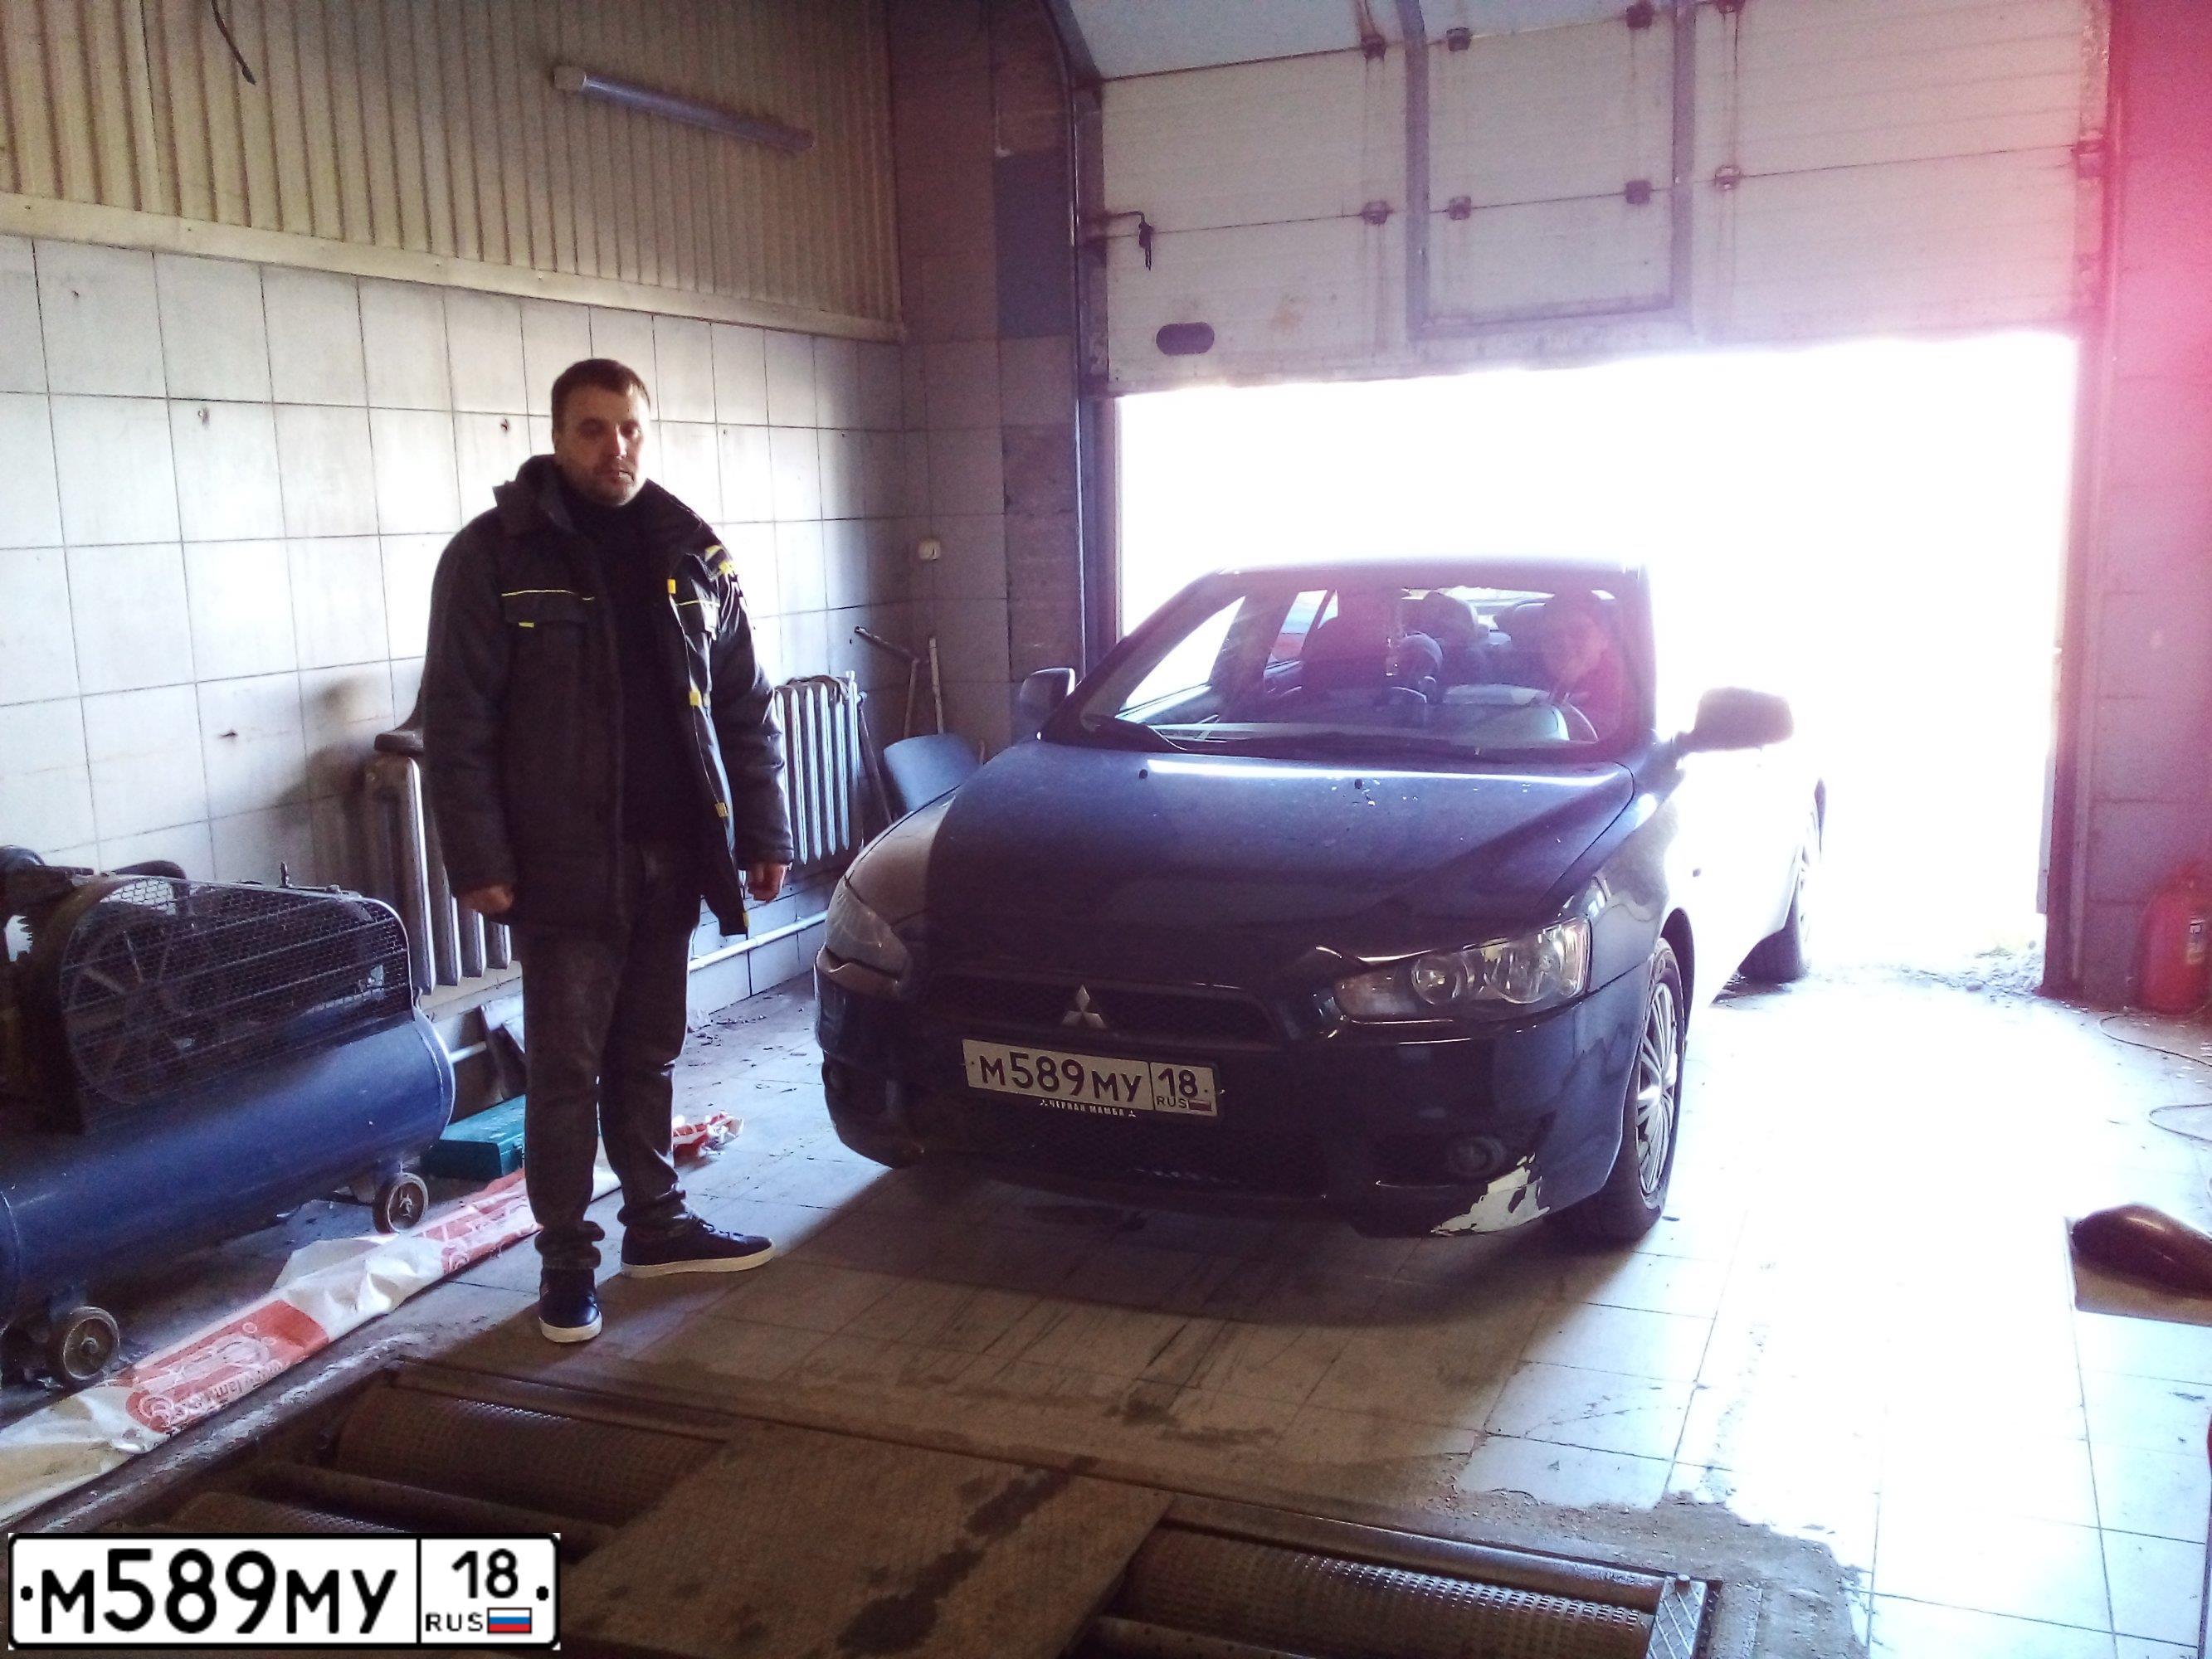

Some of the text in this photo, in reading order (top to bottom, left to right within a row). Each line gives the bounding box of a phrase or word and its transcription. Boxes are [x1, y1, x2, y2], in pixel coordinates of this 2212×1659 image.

[978, 1050, 1199, 1103] М589МУ 18
[1156, 1095, 1188, 1110] RUS
[1089, 1104, 1125, 1117] МАМБА
